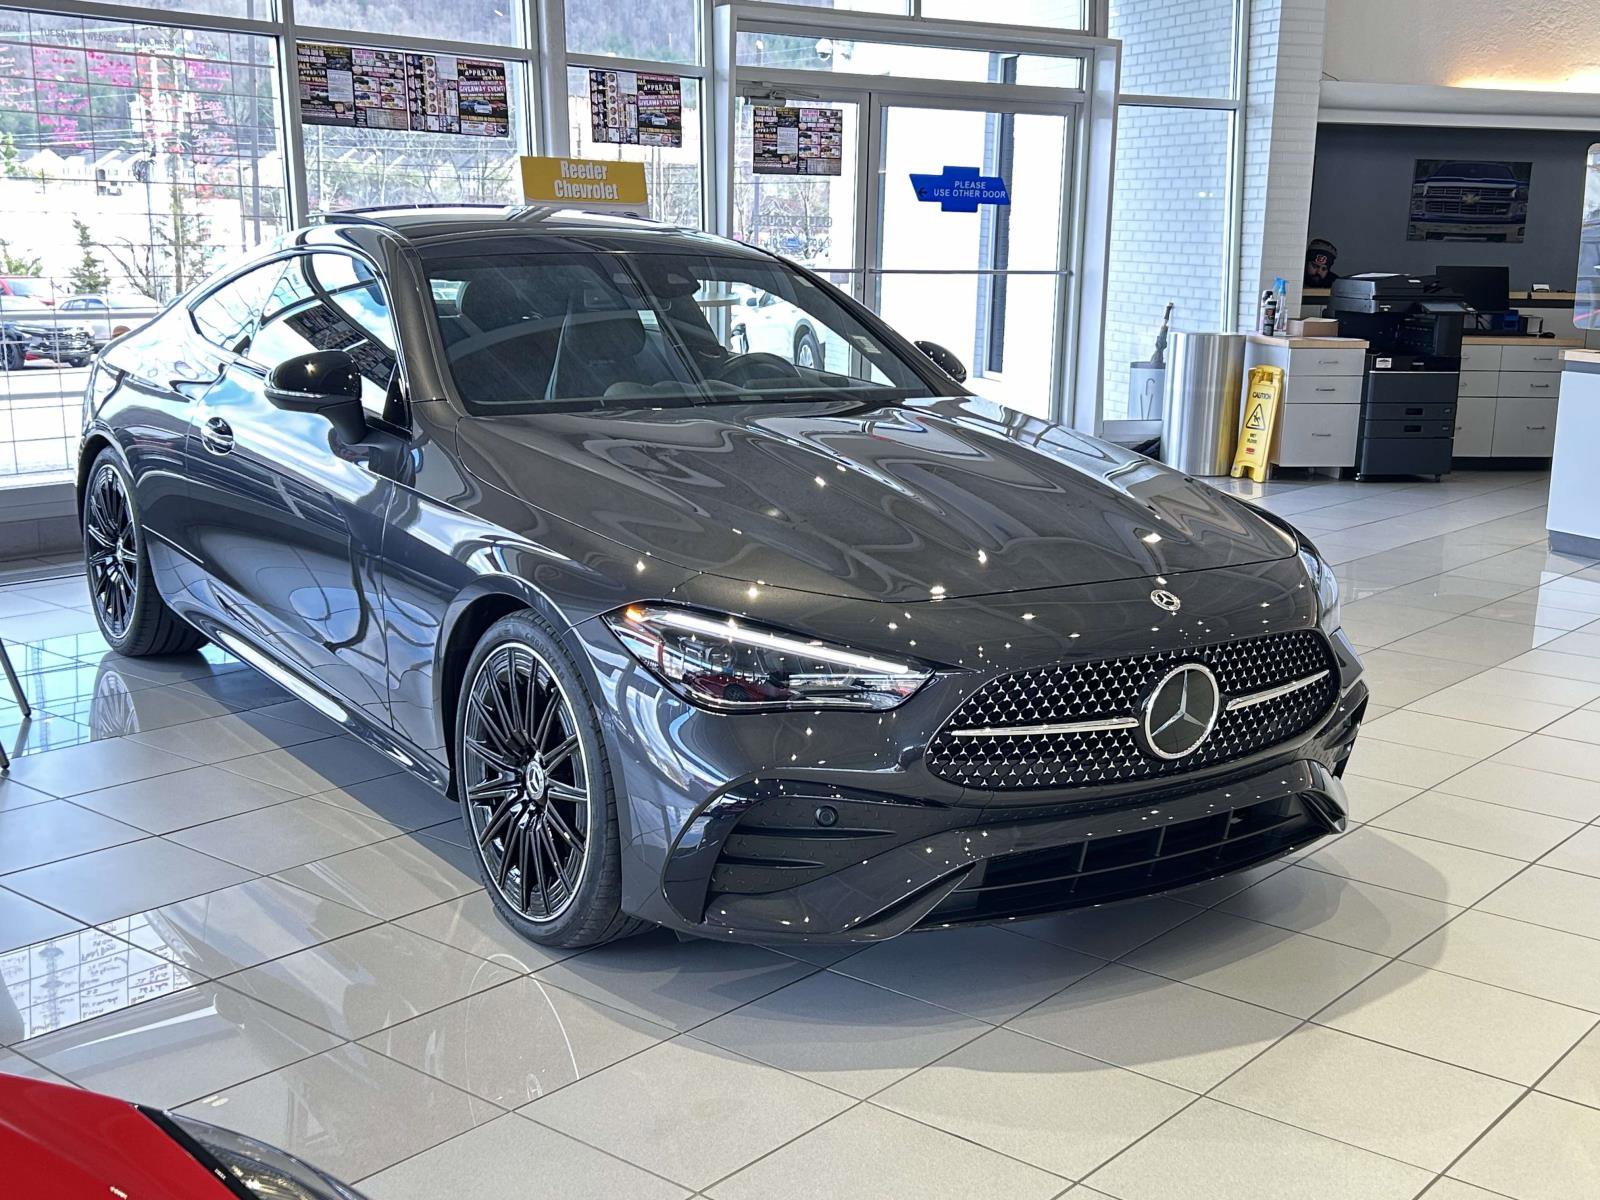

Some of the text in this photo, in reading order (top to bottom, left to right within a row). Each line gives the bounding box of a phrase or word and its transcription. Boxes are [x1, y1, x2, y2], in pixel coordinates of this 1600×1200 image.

[40, 27, 78, 40] TUESDAY
[560, 160, 608, 179] Reeder
[554, 179, 619, 199] Chevrolet
[954, 180, 986, 189] PLEASE
[933, 188, 1006, 198] USE OTHER DOOR
[1252, 391, 1271, 399] CAUTION
